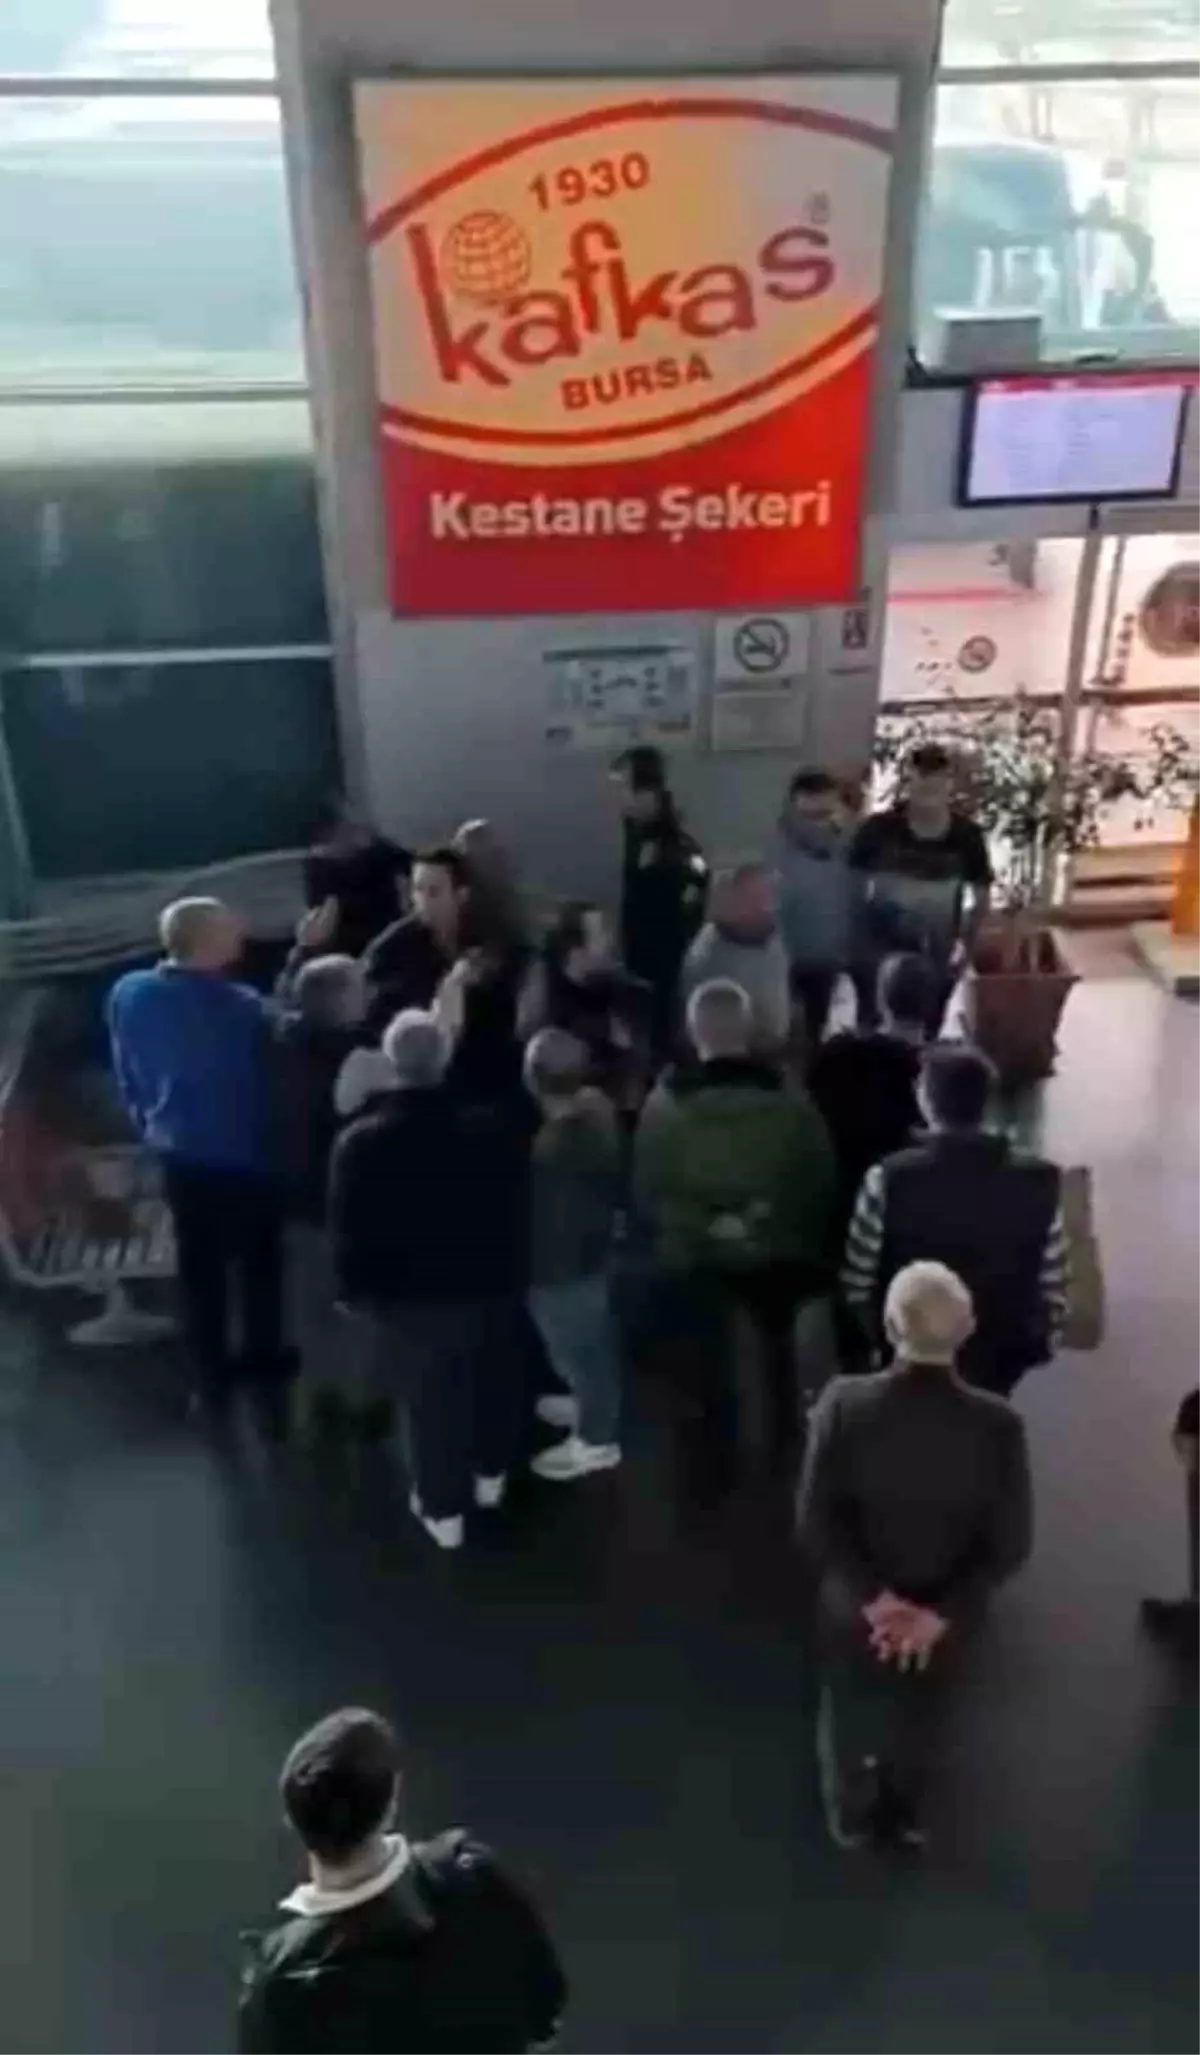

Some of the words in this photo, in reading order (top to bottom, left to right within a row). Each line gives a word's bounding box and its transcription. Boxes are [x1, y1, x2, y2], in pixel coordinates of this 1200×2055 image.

[528, 153, 650, 211] 1930
[407, 221, 835, 387] kafkas
[561, 354, 713, 411] BURSA
[430, 491, 645, 539] Kestane
[659, 481, 832, 543] Şekeri
